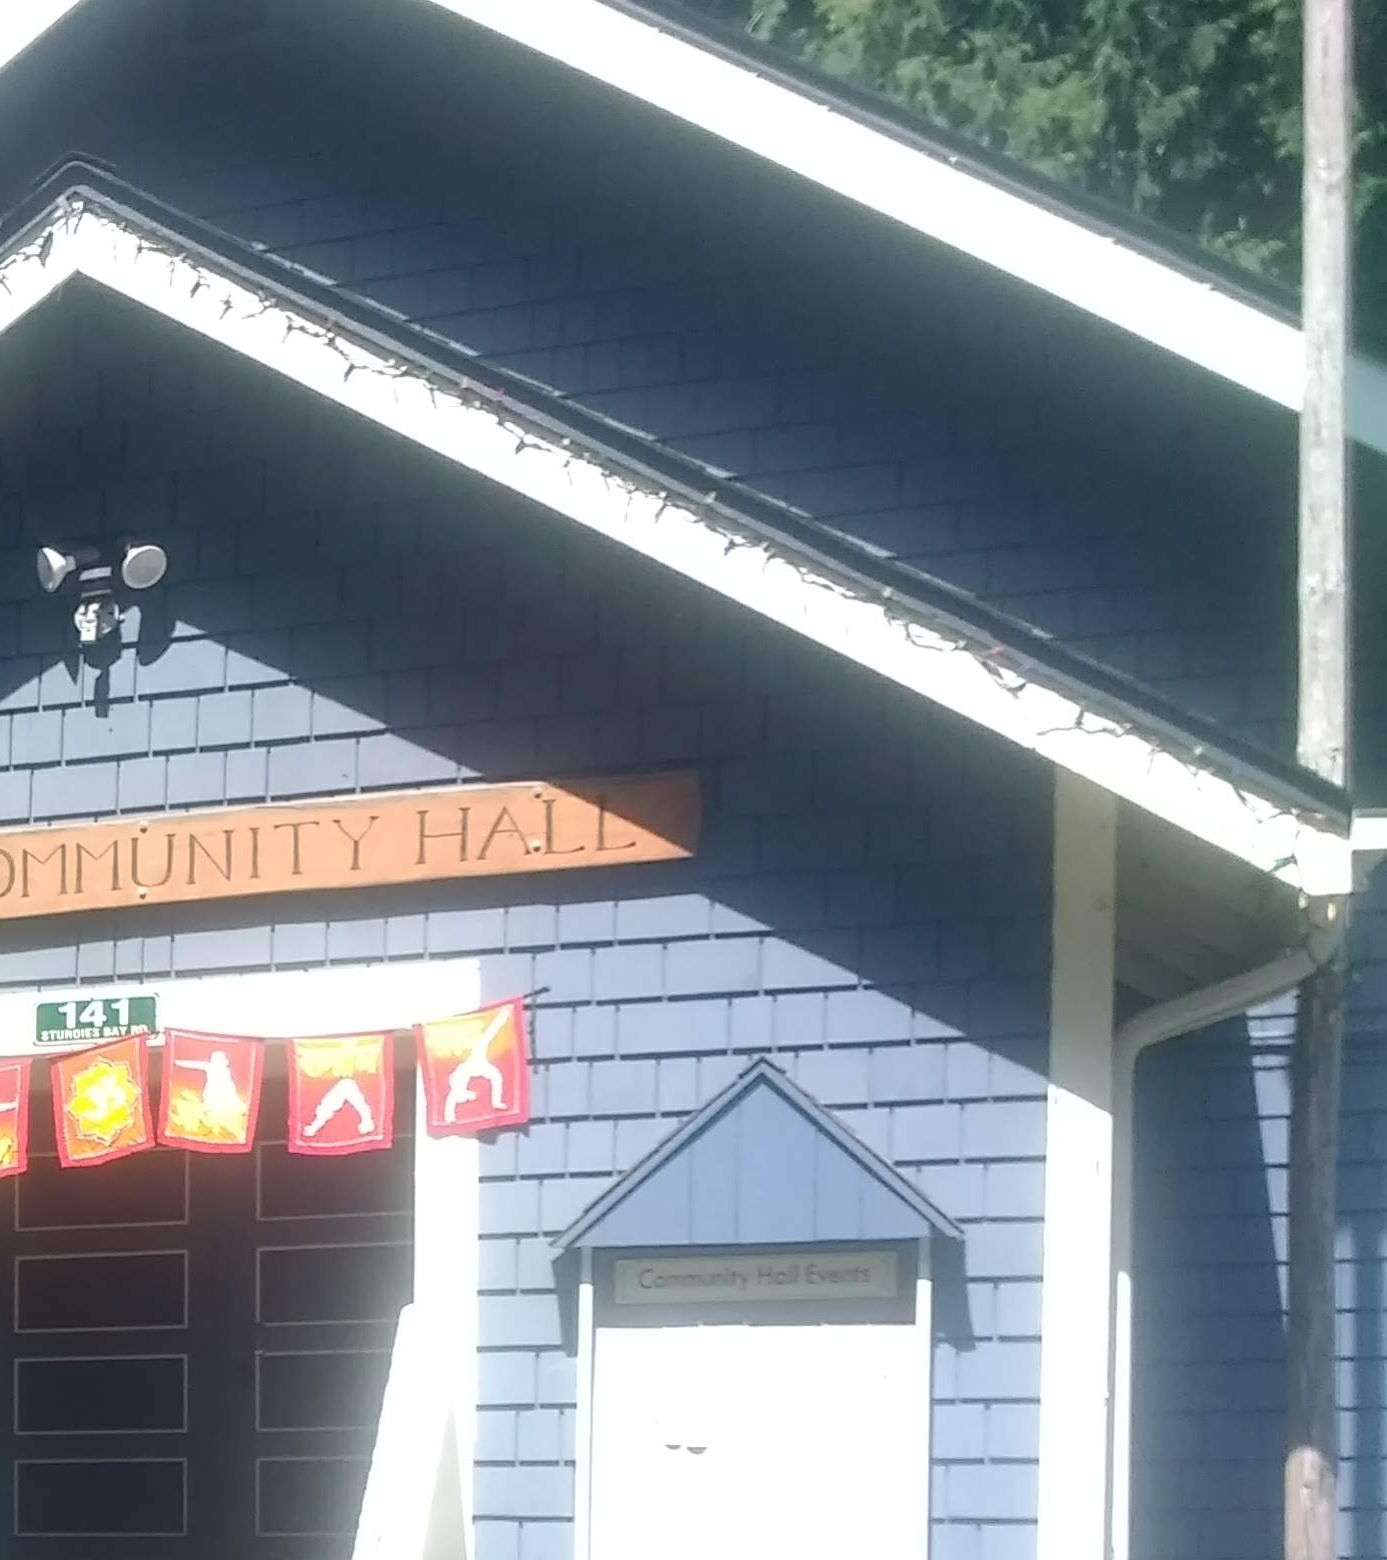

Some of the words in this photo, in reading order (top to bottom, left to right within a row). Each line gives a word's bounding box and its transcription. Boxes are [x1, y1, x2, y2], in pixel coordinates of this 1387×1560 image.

[415, 793, 638, 865] HALL
[58, 998, 129, 1029] 141
[40, 1027, 101, 1041] STURDIES
[103, 1026, 128, 1038] BAY
[638, 1267, 748, 1291] Community
[756, 1264, 800, 1285] Hall
[805, 1263, 870, 1284] Events
